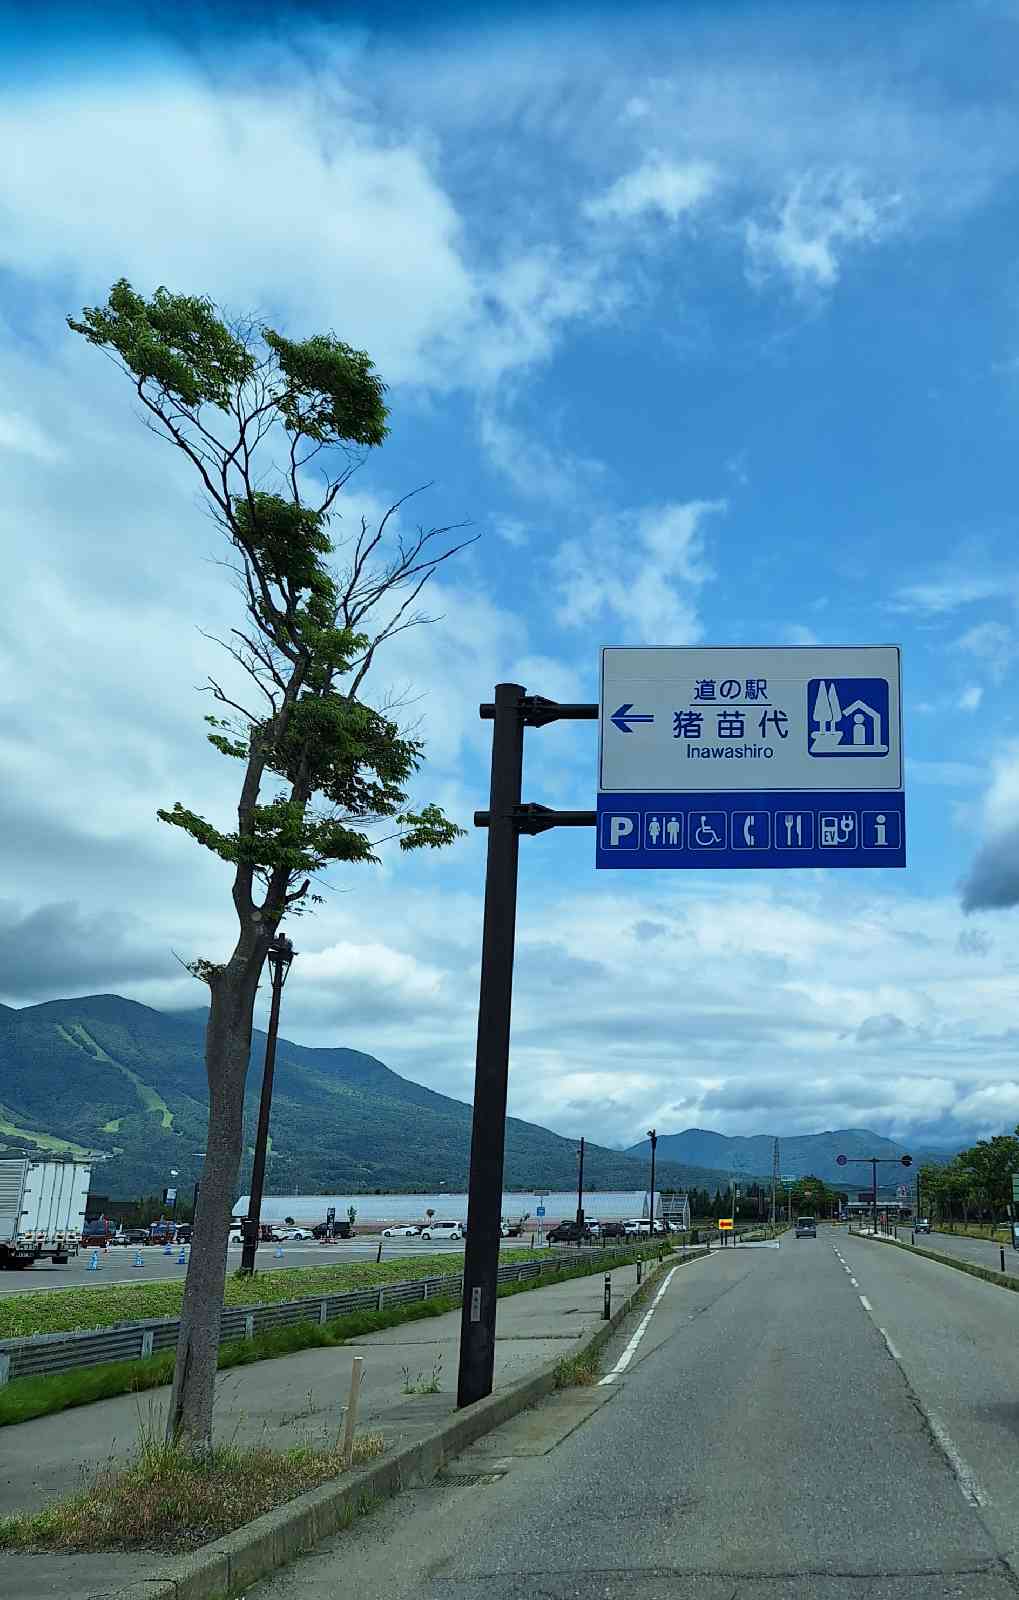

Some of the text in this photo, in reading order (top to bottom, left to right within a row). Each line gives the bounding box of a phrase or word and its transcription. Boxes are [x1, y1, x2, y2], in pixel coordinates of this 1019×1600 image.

[694, 679, 768, 701] 道の駅
[672, 710, 789, 739] 猪苗代
[687, 743, 774, 759] Inawashiro
[610, 816, 634, 846] P
[824, 831, 835, 842] EV
